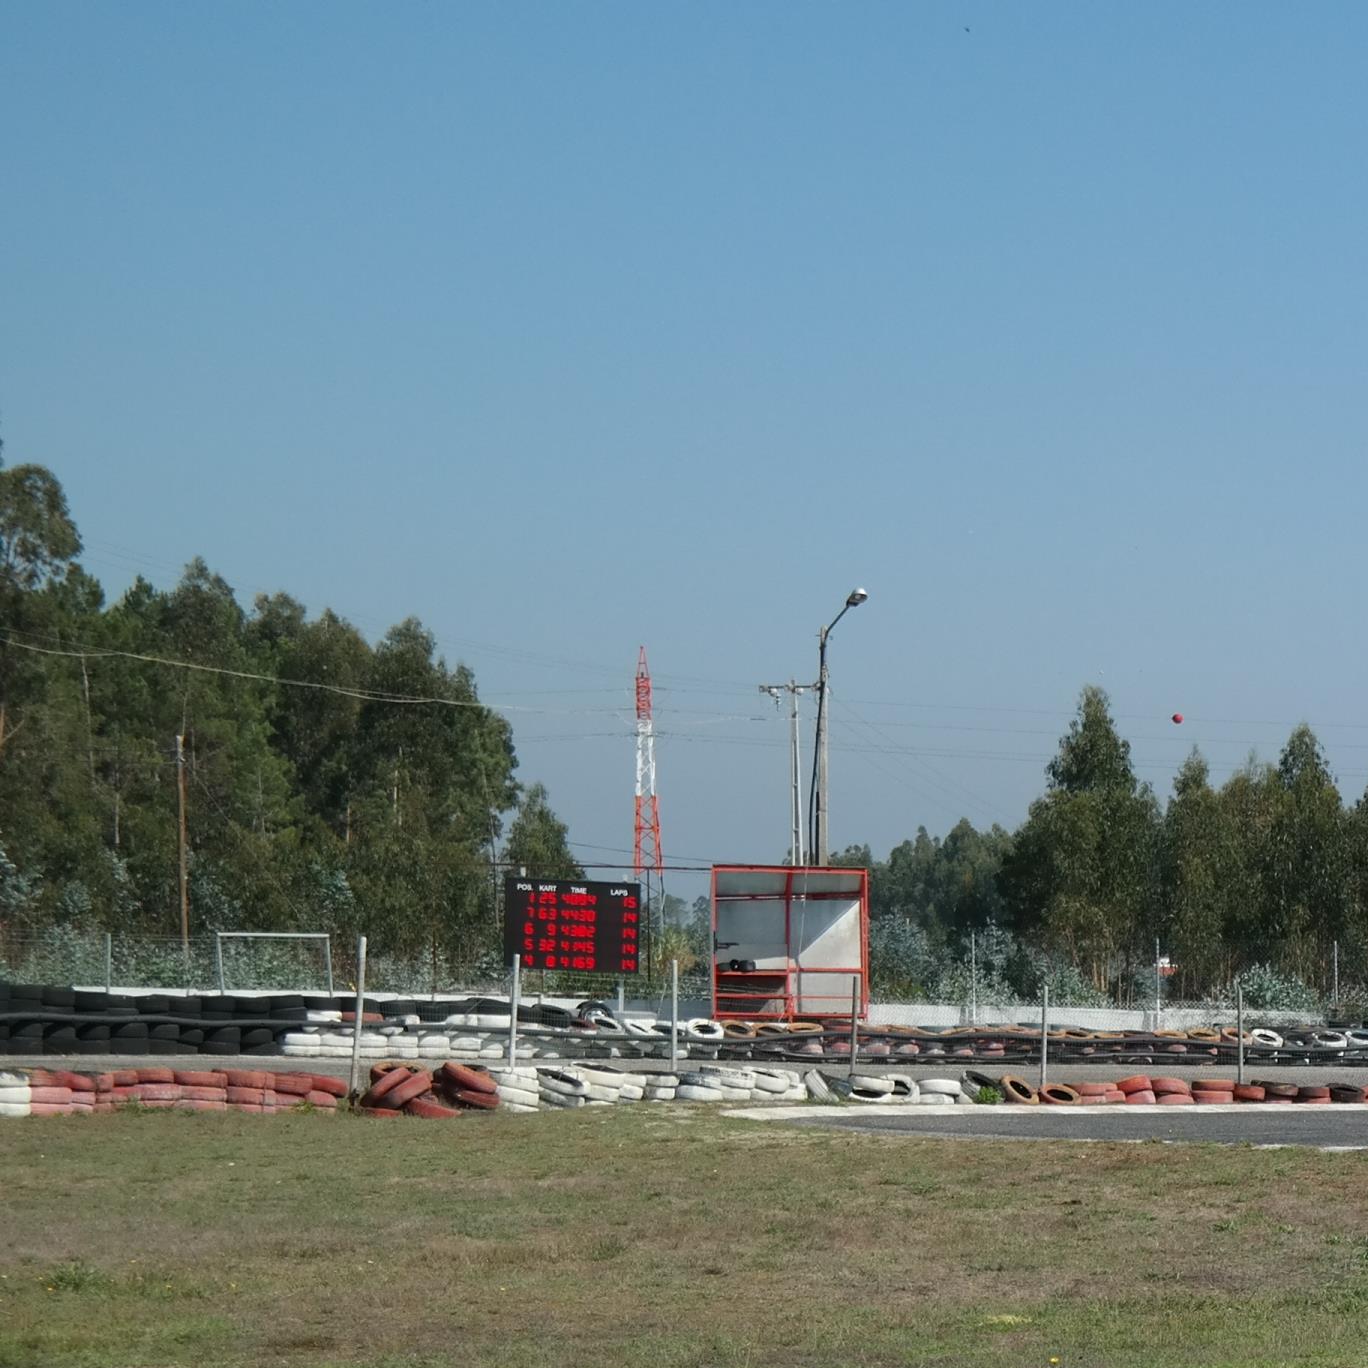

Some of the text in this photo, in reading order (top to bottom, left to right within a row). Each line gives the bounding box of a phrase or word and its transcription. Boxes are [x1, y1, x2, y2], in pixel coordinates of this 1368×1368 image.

[570, 886, 588, 894] TIME
[538, 908, 558, 920] 63
[623, 912, 637, 923] 14
[524, 921, 534, 935] 6
[524, 938, 534, 950] 5
